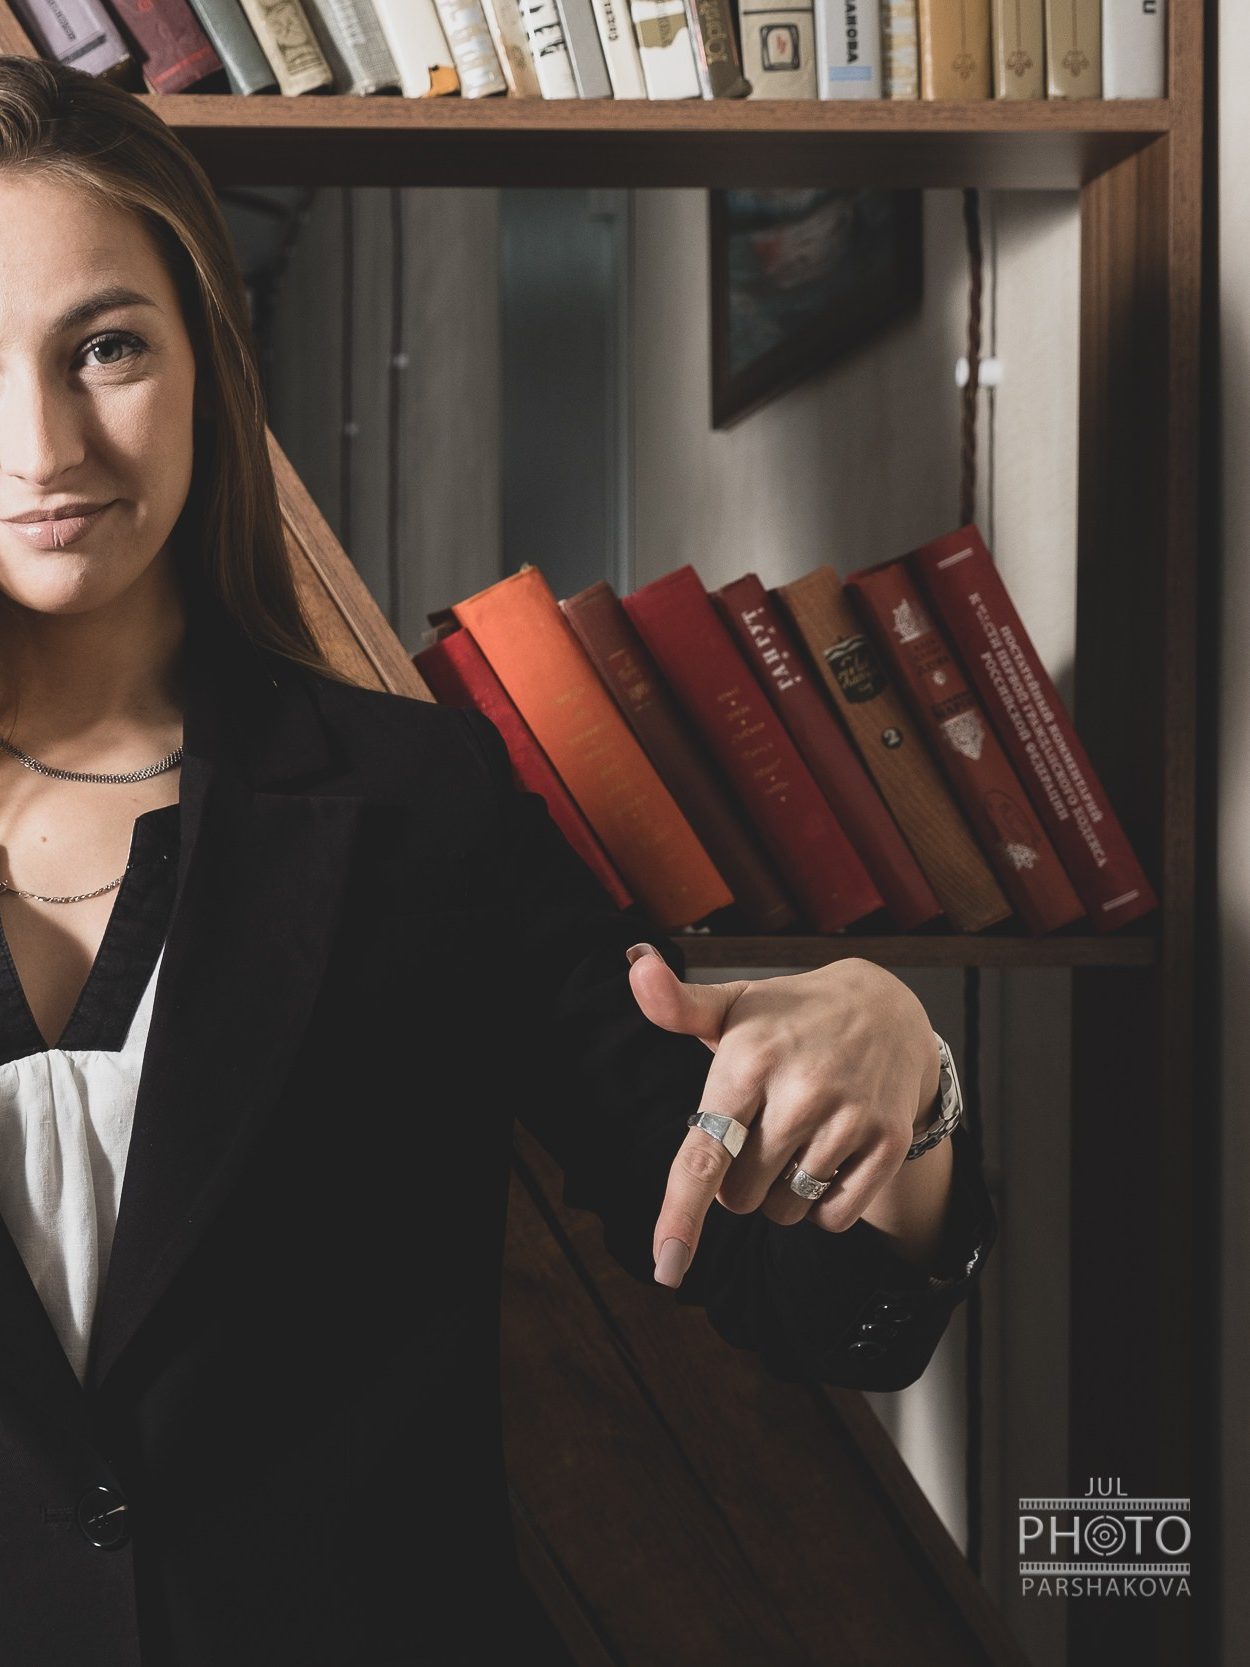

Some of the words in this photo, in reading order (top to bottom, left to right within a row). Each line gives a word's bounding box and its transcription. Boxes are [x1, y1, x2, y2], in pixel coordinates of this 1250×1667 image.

[844, 0, 859, 64] АНОВА
[741, 607, 802, 691] ГАНГУТ
[884, 728, 900, 746] 2
